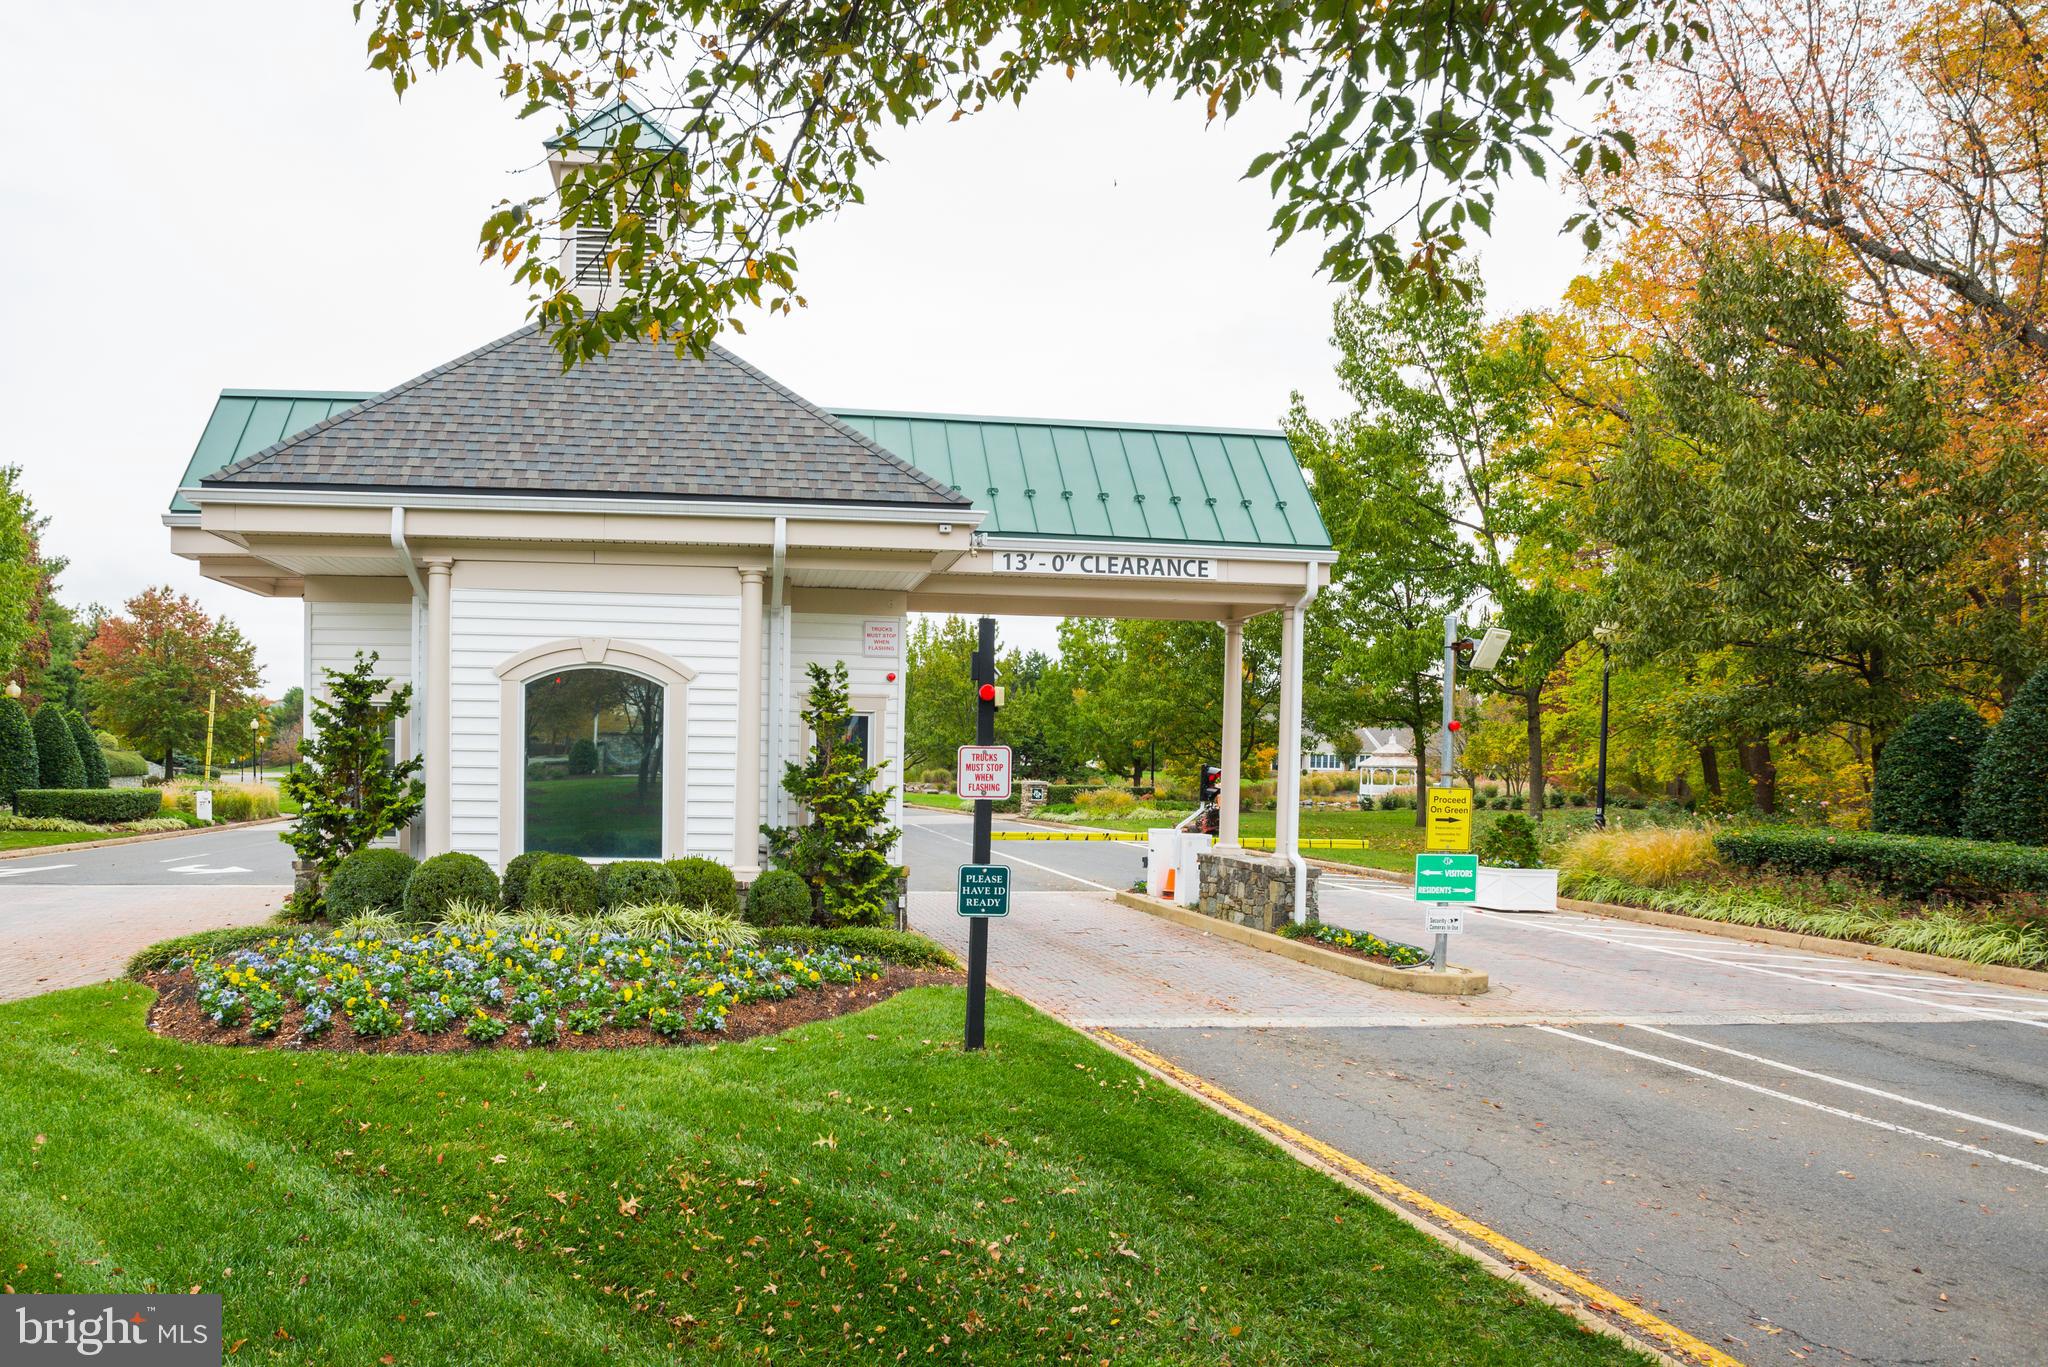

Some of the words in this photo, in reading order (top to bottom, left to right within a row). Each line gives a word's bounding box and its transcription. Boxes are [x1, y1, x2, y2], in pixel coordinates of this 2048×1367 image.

[1080, 555, 1209, 578] CLEARANCE
[972, 753, 998, 761] TRUCKS
[965, 763, 984, 771] MUST
[986, 763, 1004, 771] STOP
[975, 773, 994, 781] WHEN
[968, 783, 1000, 791] FLASHING
[1433, 795, 1467, 804] Proceed
[1430, 805, 1442, 813] On
[1444, 806, 1469, 814] Green
[1444, 869, 1473, 878] VISITORS
[966, 874, 1003, 884] PLEASE
[962, 886, 991, 895] HAVE
[994, 887, 1006, 895] ID
[1417, 886, 1452, 894] RESIDENTS
[966, 898, 1001, 907] READY
